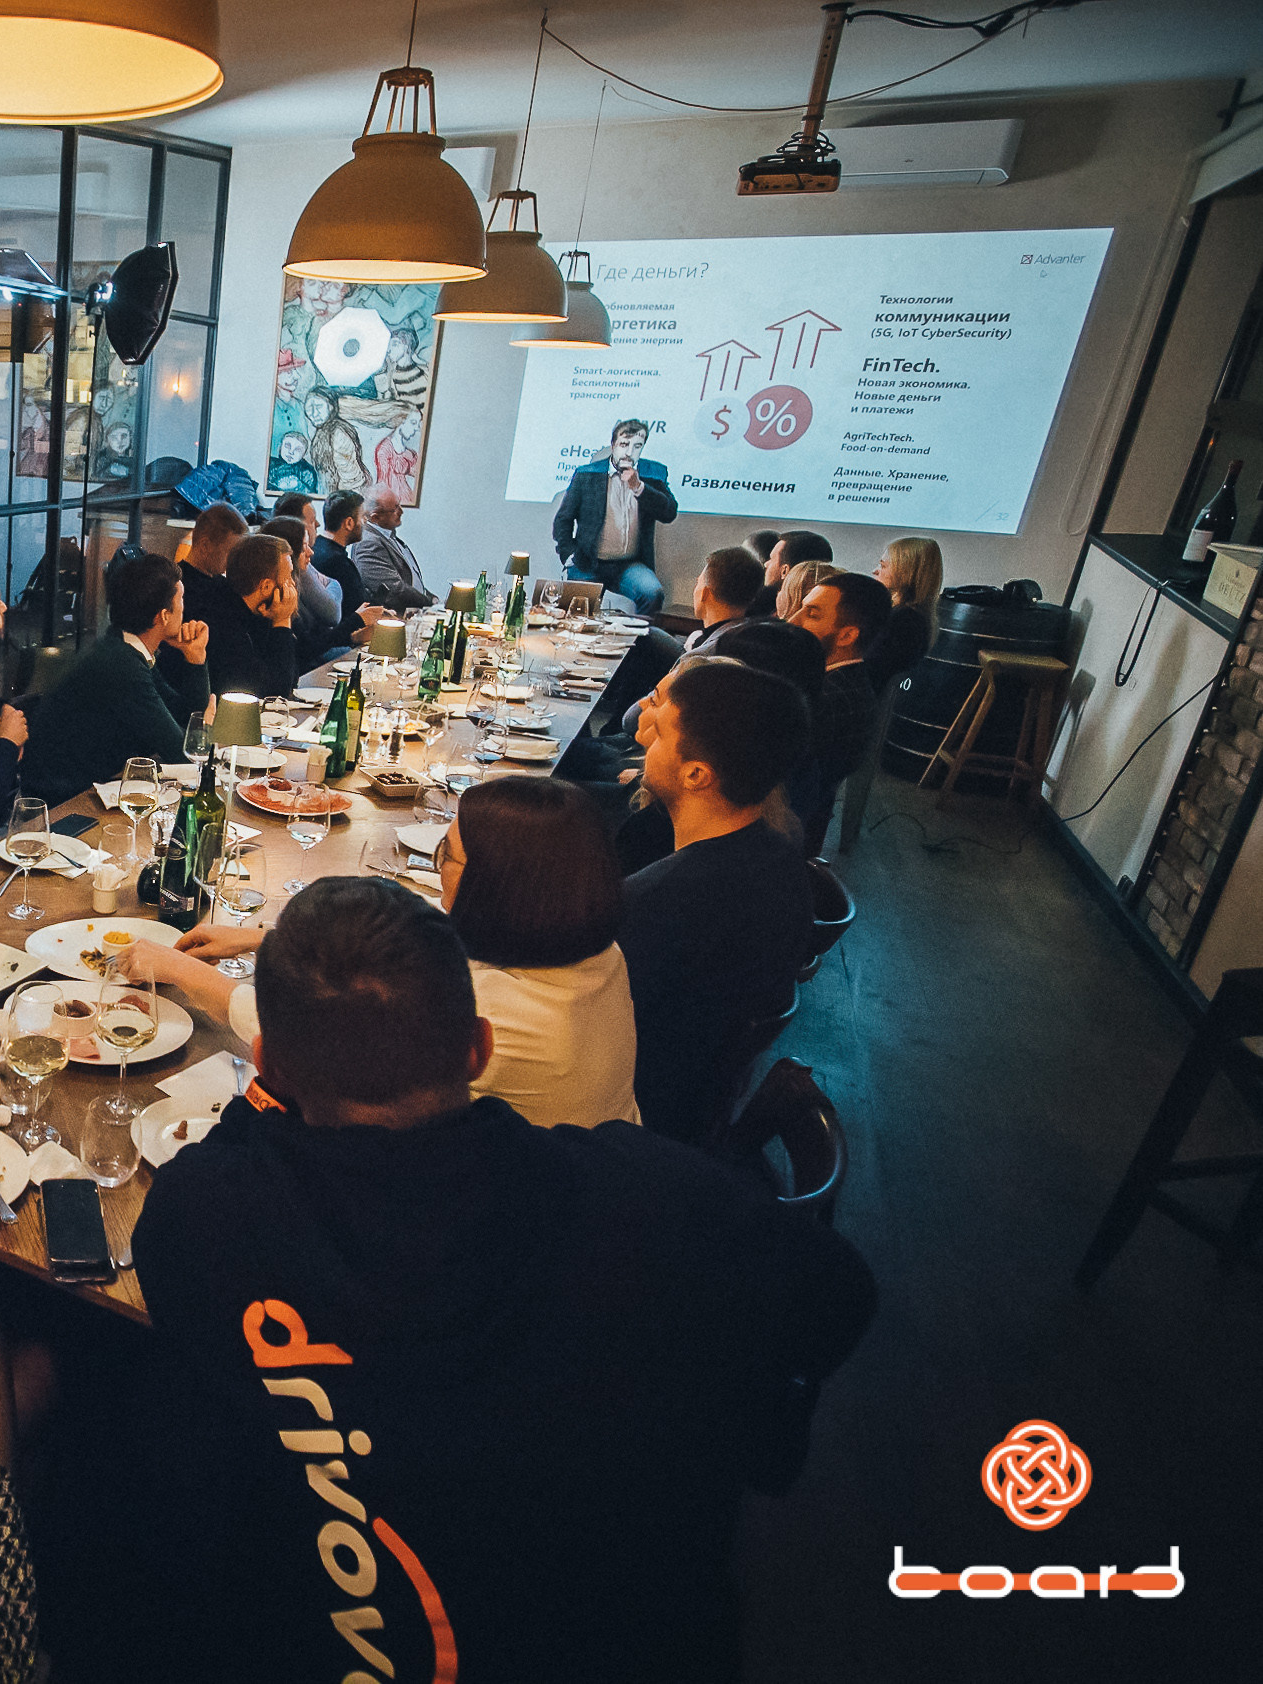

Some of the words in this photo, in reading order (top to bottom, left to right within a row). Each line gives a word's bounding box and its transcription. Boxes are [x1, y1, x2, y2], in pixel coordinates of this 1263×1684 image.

[1034, 253, 1087, 265] Advanter
[596, 264, 628, 281] Где
[631, 262, 709, 281] деньги?
[879, 294, 954, 304] Технологии
[604, 301, 675, 311] обновляемая
[874, 312, 1011, 326] коммуникации
[611, 319, 678, 333] ргетика
[871, 327, 894, 339] (5G,
[898, 327, 919, 338] IoT
[921, 327, 1012, 341] CyberSecurity)
[613, 337, 638, 345] ение
[640, 336, 684, 347] энергии
[862, 357, 941, 373] FinTech.
[573, 366, 662, 377] Smart-логистика.
[571, 378, 641, 388] Беспилотный
[857, 377, 896, 388] Новая
[898, 379, 971, 390] экономика.
[569, 391, 622, 402] транспорт
[853, 390, 896, 401] Новые
[896, 392, 942, 403] деньги
[861, 405, 915, 415] платежи
[843, 432, 915, 443] AgriTechTech.
[559, 444, 600, 458] eHea
[840, 443, 931, 455] Food-on-demand
[833, 466, 885, 478] Данные.
[887, 469, 950, 483] Хранение,
[681, 474, 796, 493] Развлечения
[830, 480, 913, 493] превращение
[827, 493, 835, 501] в
[837, 493, 891, 504] решения
